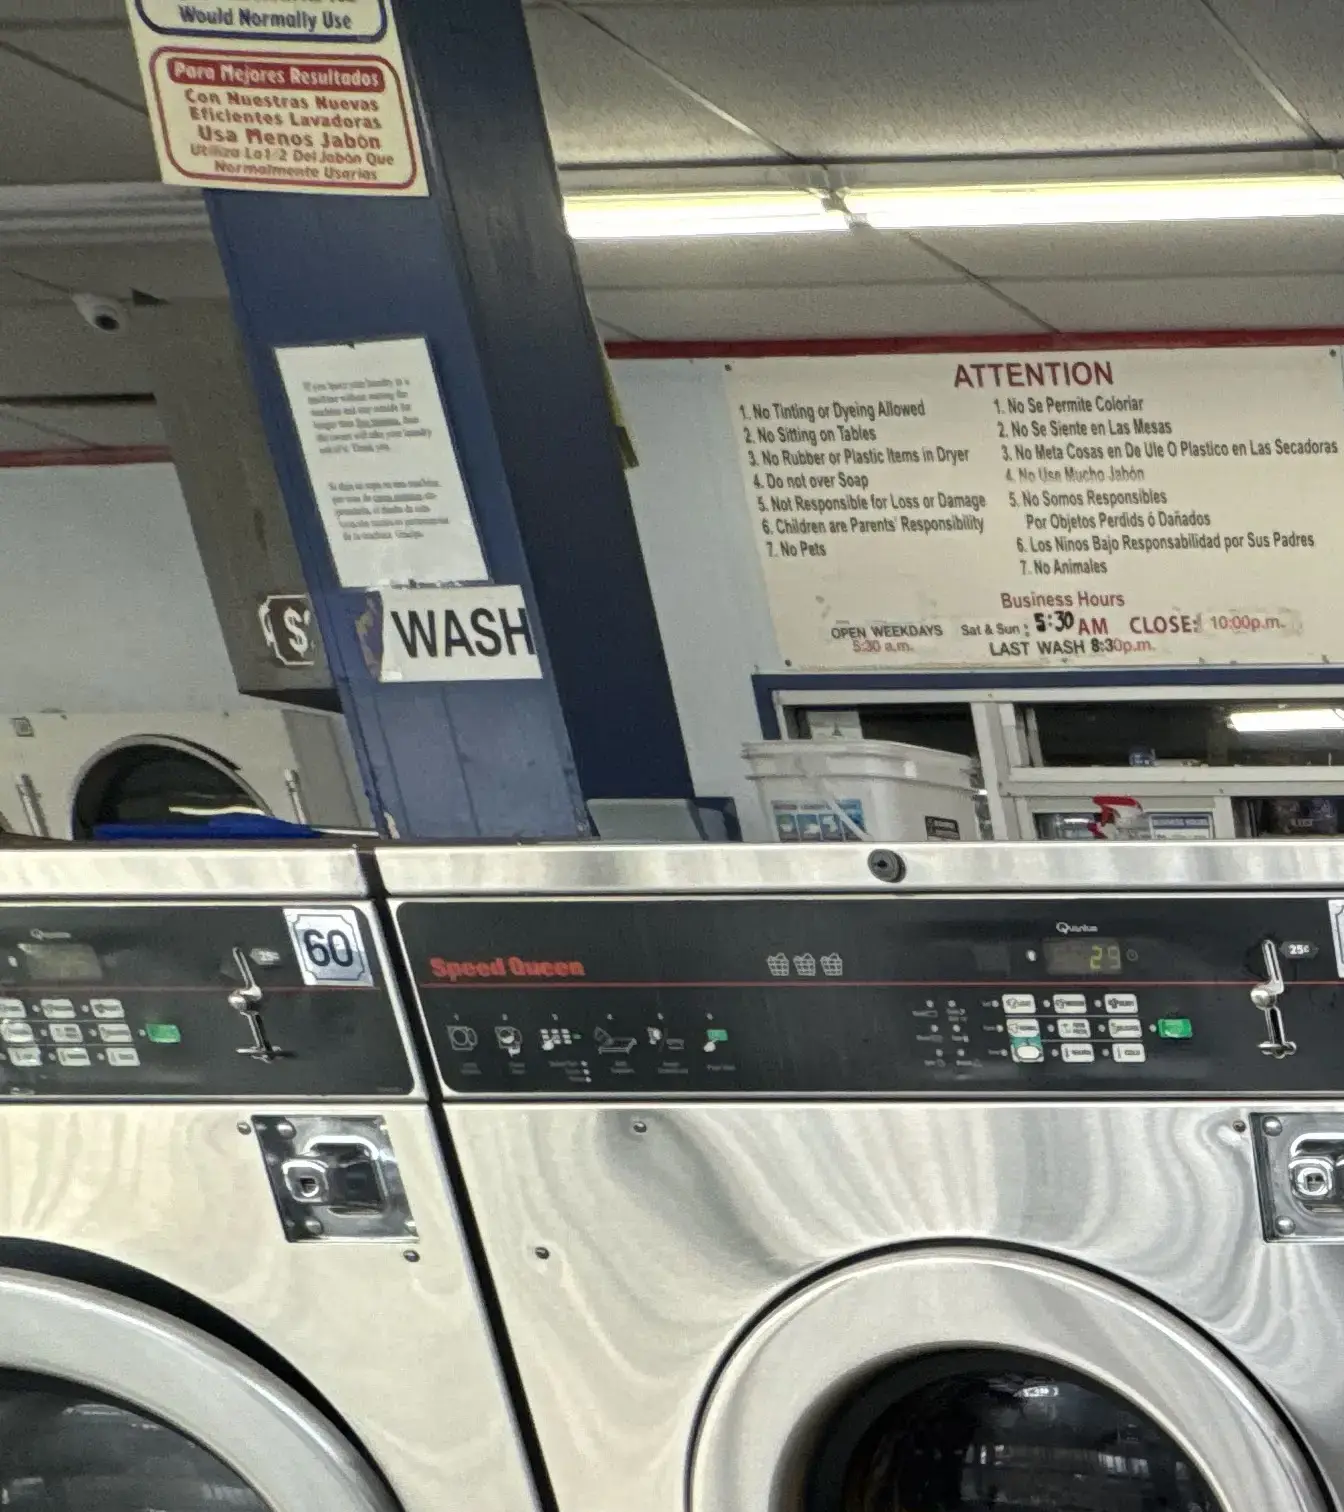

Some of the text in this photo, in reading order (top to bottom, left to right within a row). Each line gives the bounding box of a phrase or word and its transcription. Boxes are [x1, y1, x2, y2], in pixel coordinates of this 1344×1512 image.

[179, 4, 353, 32] Would Normally Use
[174, 61, 380, 87] Para Mejores Resultados
[184, 88, 380, 112] Con Nuestras Nuevas
[190, 106, 382, 129] Eficientes Lavadoras
[198, 125, 314, 146] Usa Menos
[215, 160, 319, 178] Normalmente
[953, 362, 1114, 388] ATTENTION
[753, 399, 926, 423] No Tinting or Dyeing Allowed
[1008, 398, 1025, 414] No
[1028, 397, 1043, 413] Se
[1047, 396, 1092, 414] Permite
[758, 424, 876, 446] No Sitting on Tables
[1011, 418, 1172, 437] No Se Siente en Las Mesas
[763, 445, 970, 466] No Rubber or Plastic Items in Dryer
[1015, 437, 1338, 460] No Meta Cosas en De Ule O Plastico en Las Secadoras
[767, 472, 868, 490] Do not over Soap
[1019, 467, 1036, 483] No
[1064, 465, 1105, 482] Mucho
[771, 491, 986, 514] Not Responsible for Loss or Damage
[1022, 488, 1167, 508] No Somos Responsibles
[776, 517, 827, 535] Children
[829, 520, 848, 533] are
[901, 514, 983, 536] Responsibility
[1026, 513, 1047, 529] Por
[1051, 512, 1096, 532] Objetos
[1158, 509, 1211, 527] Dañados
[780, 540, 827, 557] No Pets
[1029, 531, 1315, 554] Los Ninos Bajo Responsabilidad por Sus Padres
[1034, 557, 1108, 575] No Animales
[1000, 590, 1125, 609] Business Hours
[391, 607, 537, 659] WASH
[831, 624, 944, 639] OPEN WEEKDAYS
[961, 610, 1109, 636] Sat & Sun 5:30 AM
[989, 641, 1030, 656] LAST
[1037, 640, 1085, 655] WASH
[303, 928, 354, 968] 60
[430, 956, 585, 981] Speed Queen
